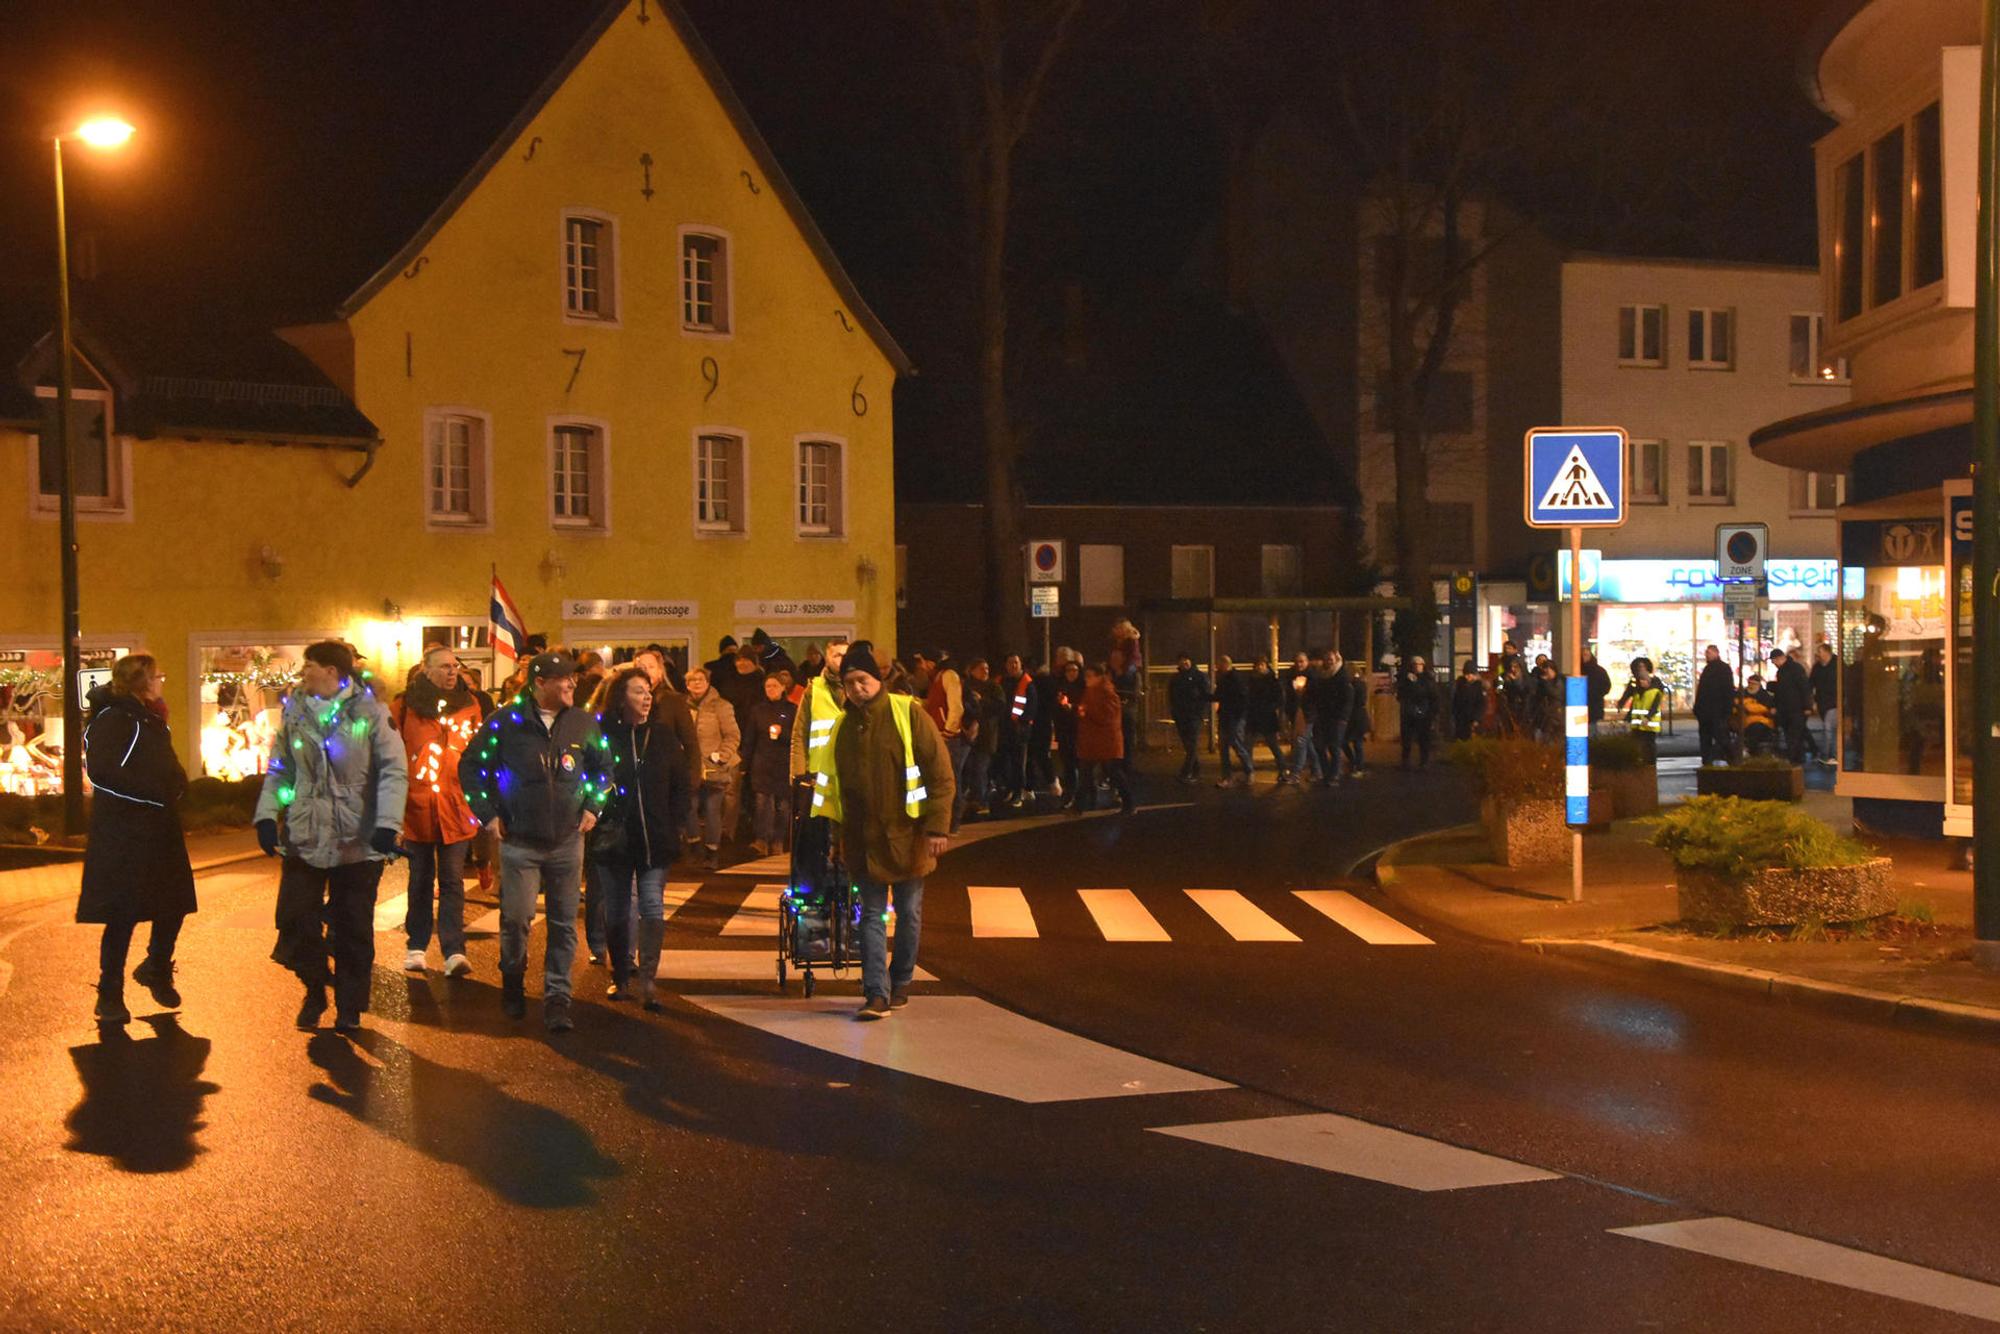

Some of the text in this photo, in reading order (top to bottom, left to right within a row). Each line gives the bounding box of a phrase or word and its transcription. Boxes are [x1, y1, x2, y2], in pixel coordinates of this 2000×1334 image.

[562, 348, 587, 394] 7
[701, 356, 719, 402] 9
[851, 374, 868, 417] 6
[1730, 566, 1754, 575] ZONE
[572, 603, 690, 618] Sawdee Thaimassage
